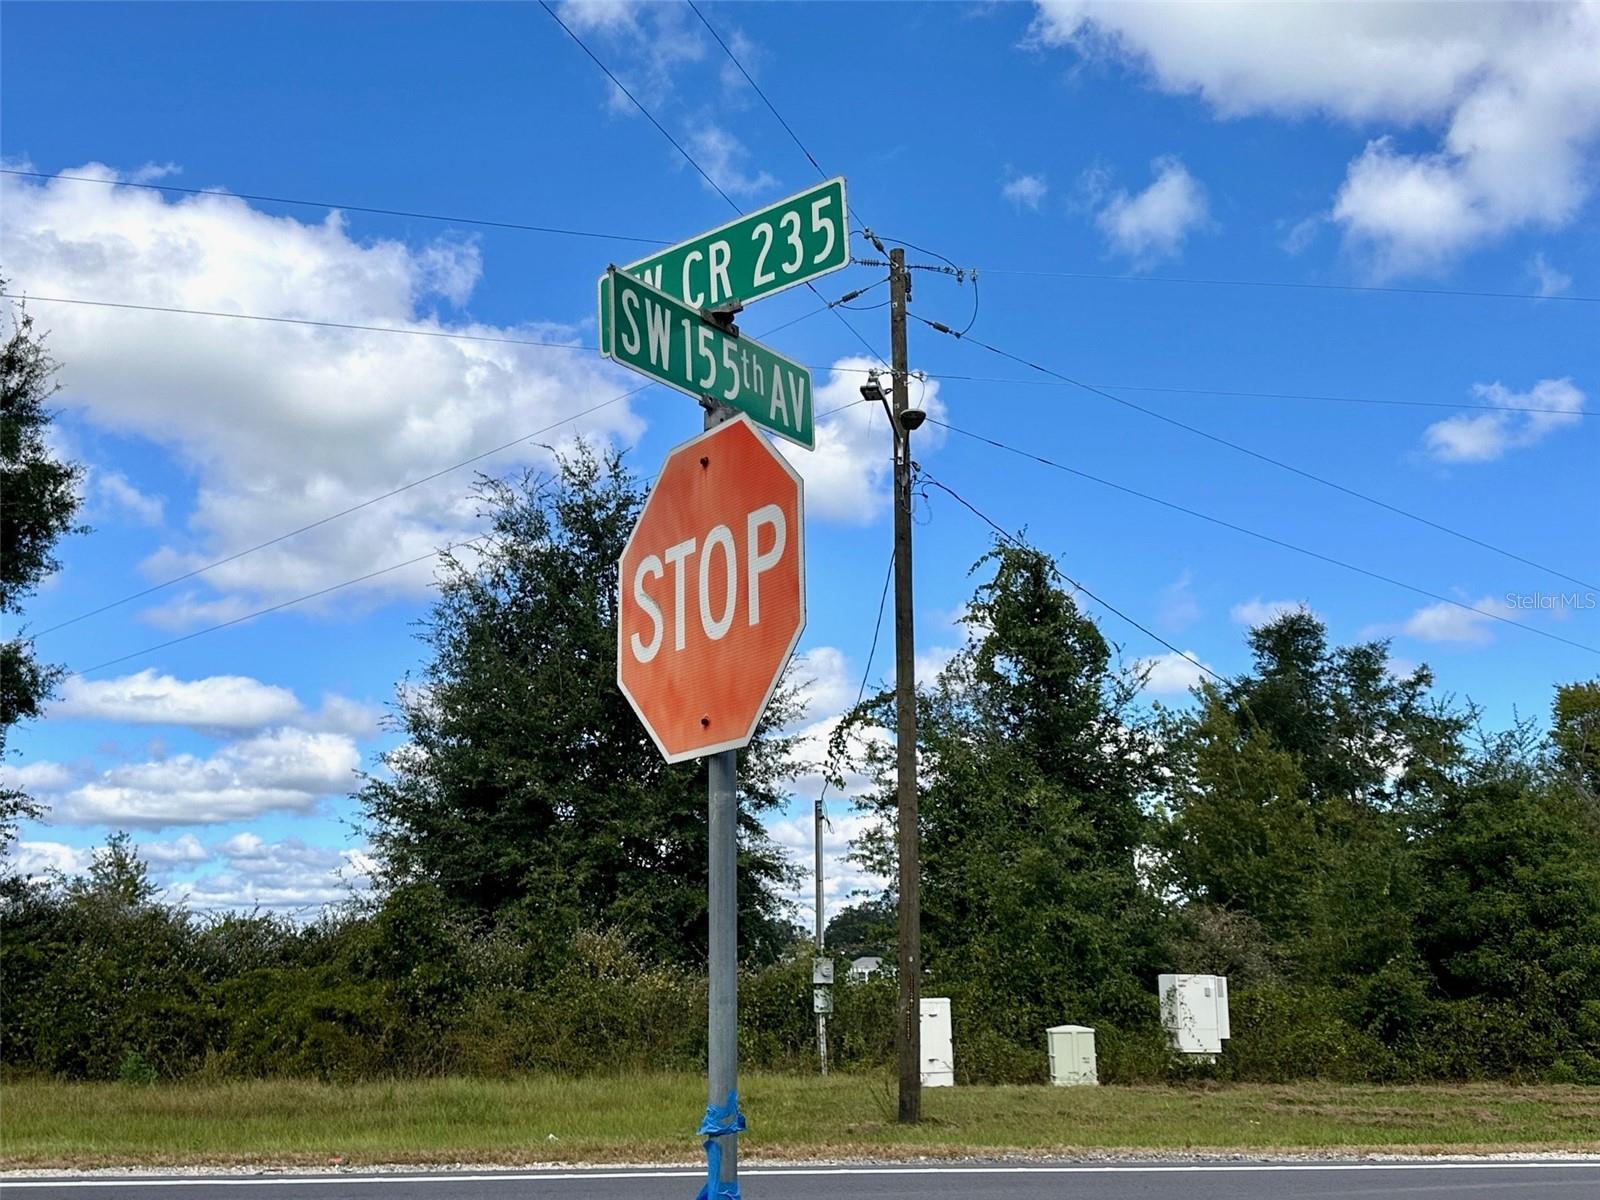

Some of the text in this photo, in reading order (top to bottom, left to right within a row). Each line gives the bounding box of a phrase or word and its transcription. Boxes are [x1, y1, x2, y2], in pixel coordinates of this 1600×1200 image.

[682, 195, 835, 309] CR 235
[621, 288, 805, 432] SW 155th AV
[631, 504, 787, 664] STOP
